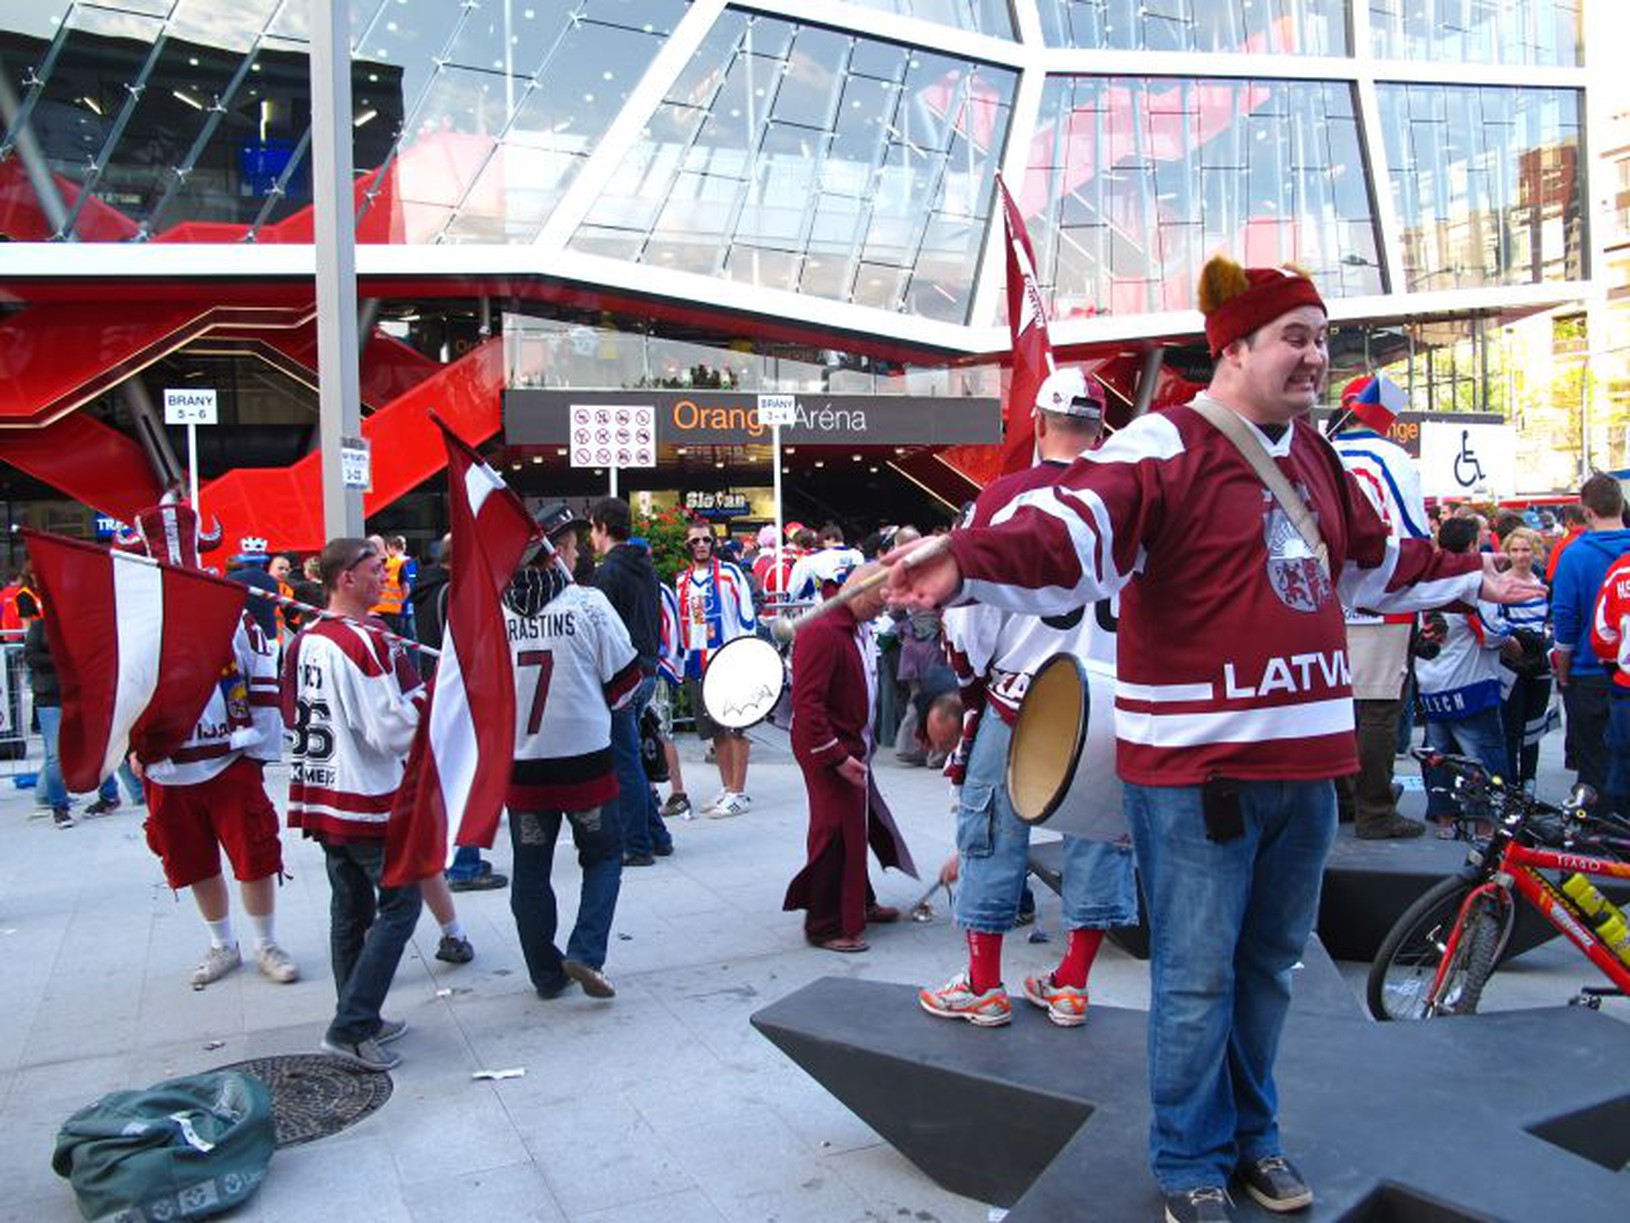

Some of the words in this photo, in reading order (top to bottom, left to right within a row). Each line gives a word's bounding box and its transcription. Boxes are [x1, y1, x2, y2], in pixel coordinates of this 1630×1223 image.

[198, 409, 207, 420] 6
[673, 400, 764, 436] Orang
[790, 403, 866, 430] Aréna
[1386, 421, 1419, 444] nge
[507, 610, 575, 641] RASTINS
[517, 649, 554, 735] 7
